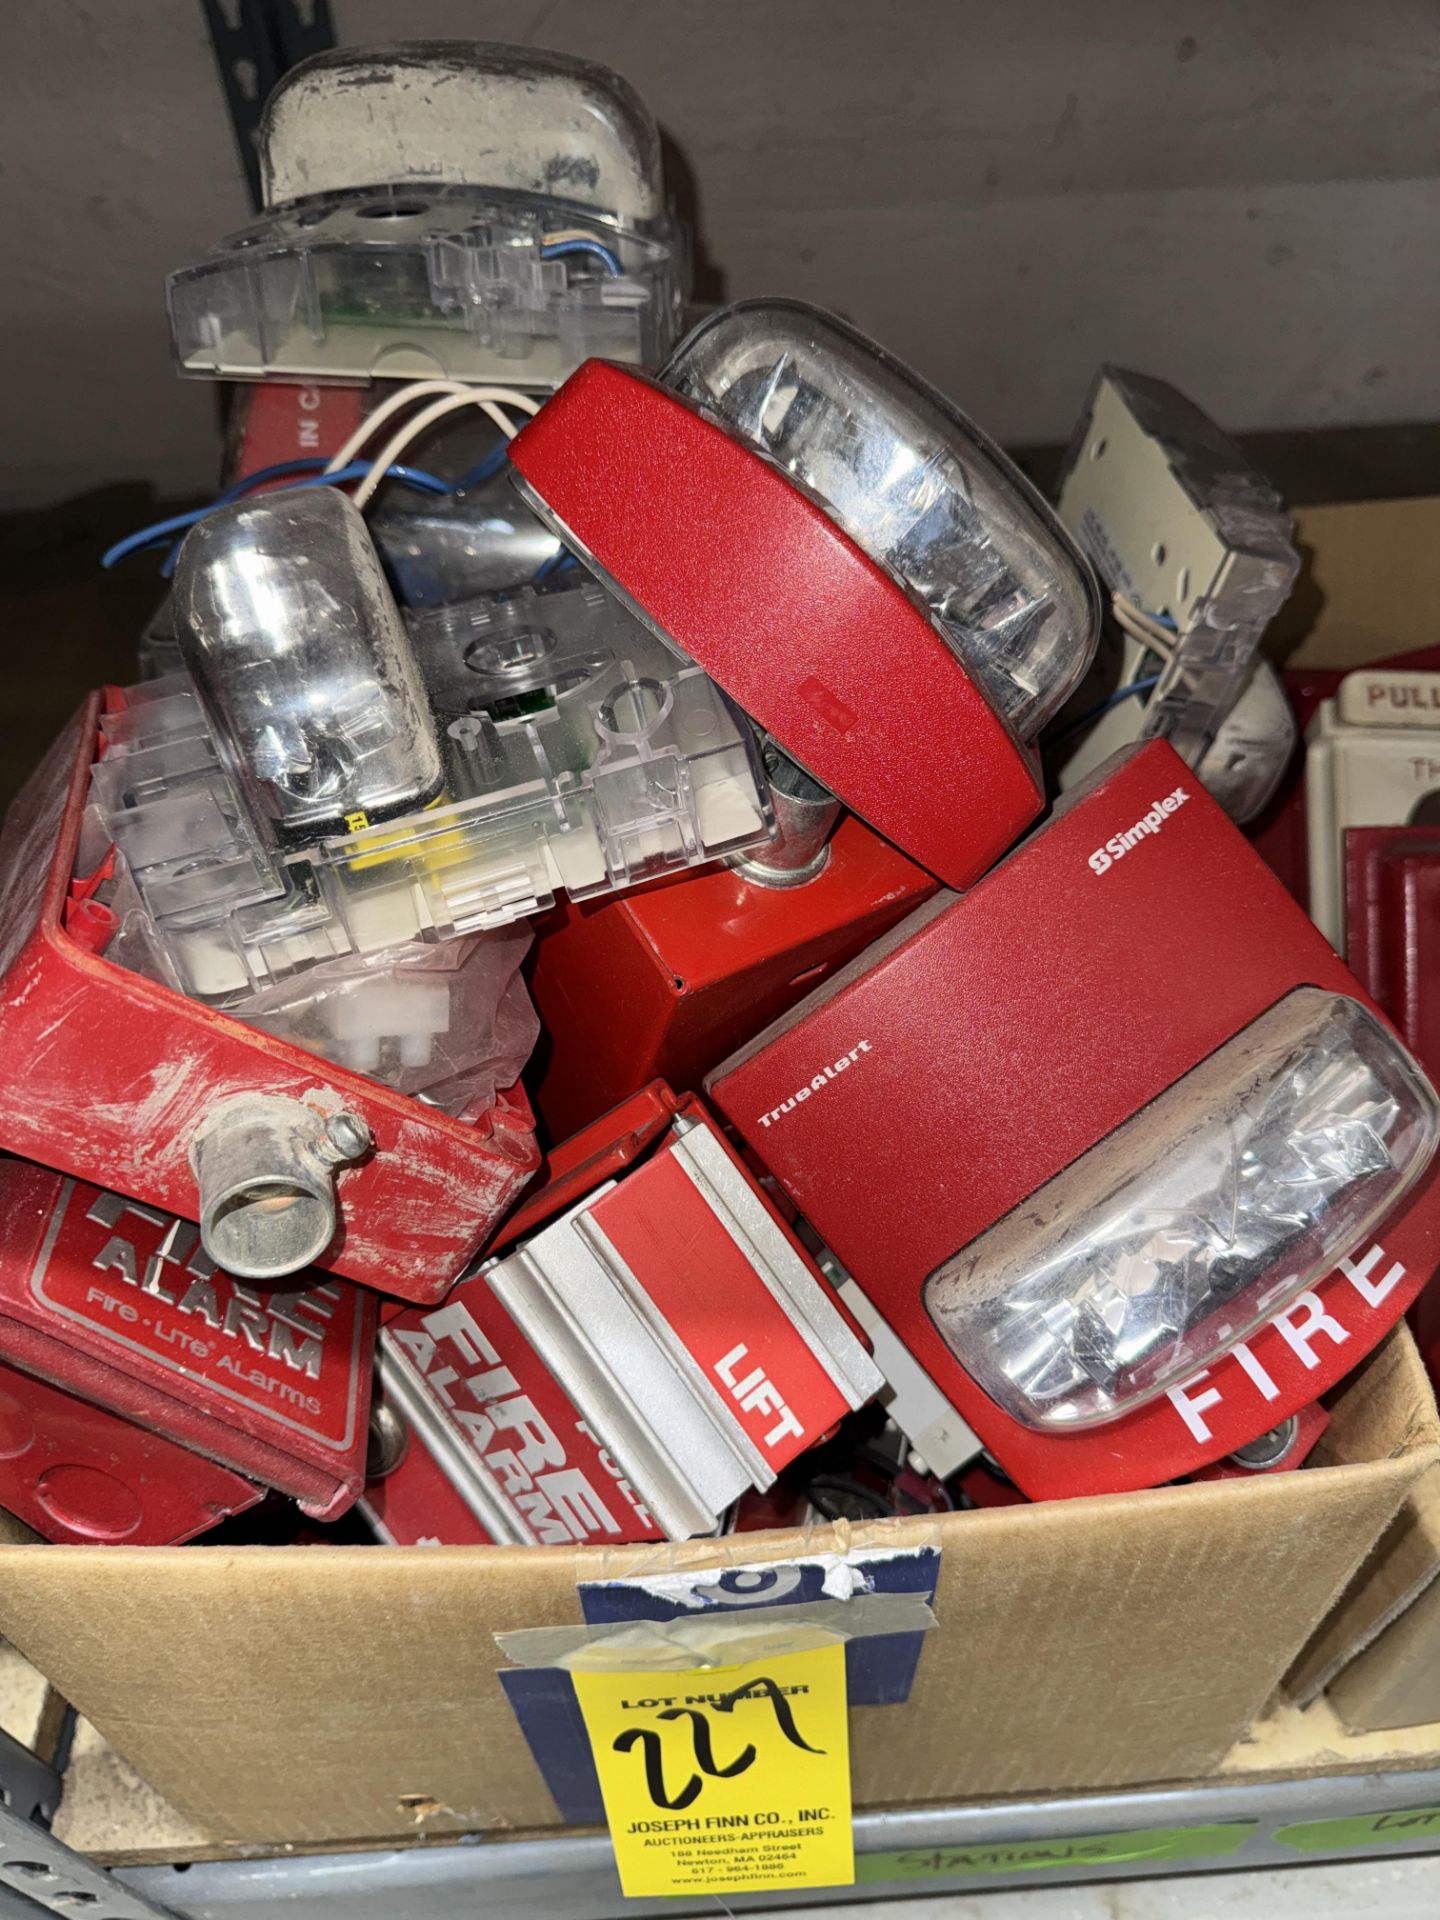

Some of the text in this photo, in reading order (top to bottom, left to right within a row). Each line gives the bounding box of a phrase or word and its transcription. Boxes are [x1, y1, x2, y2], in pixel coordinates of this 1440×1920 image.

[1105, 786, 1191, 861] Simplex
[757, 1039, 873, 1128] TrueAlert
[92, 1235, 324, 1381] ALARM
[1166, 1243, 1407, 1444] FIRE
[393, 1328, 574, 1545] ALARM
[420, 1300, 622, 1534] FIRE
[713, 1342, 805, 1447] LIFT
[621, 1697, 677, 1709] LOT
[627, 1807, 836, 1834] JOSEPH FINN CO., INC.
[733, 1855, 756, 1863] MA
[762, 1843, 802, 1852] Street
